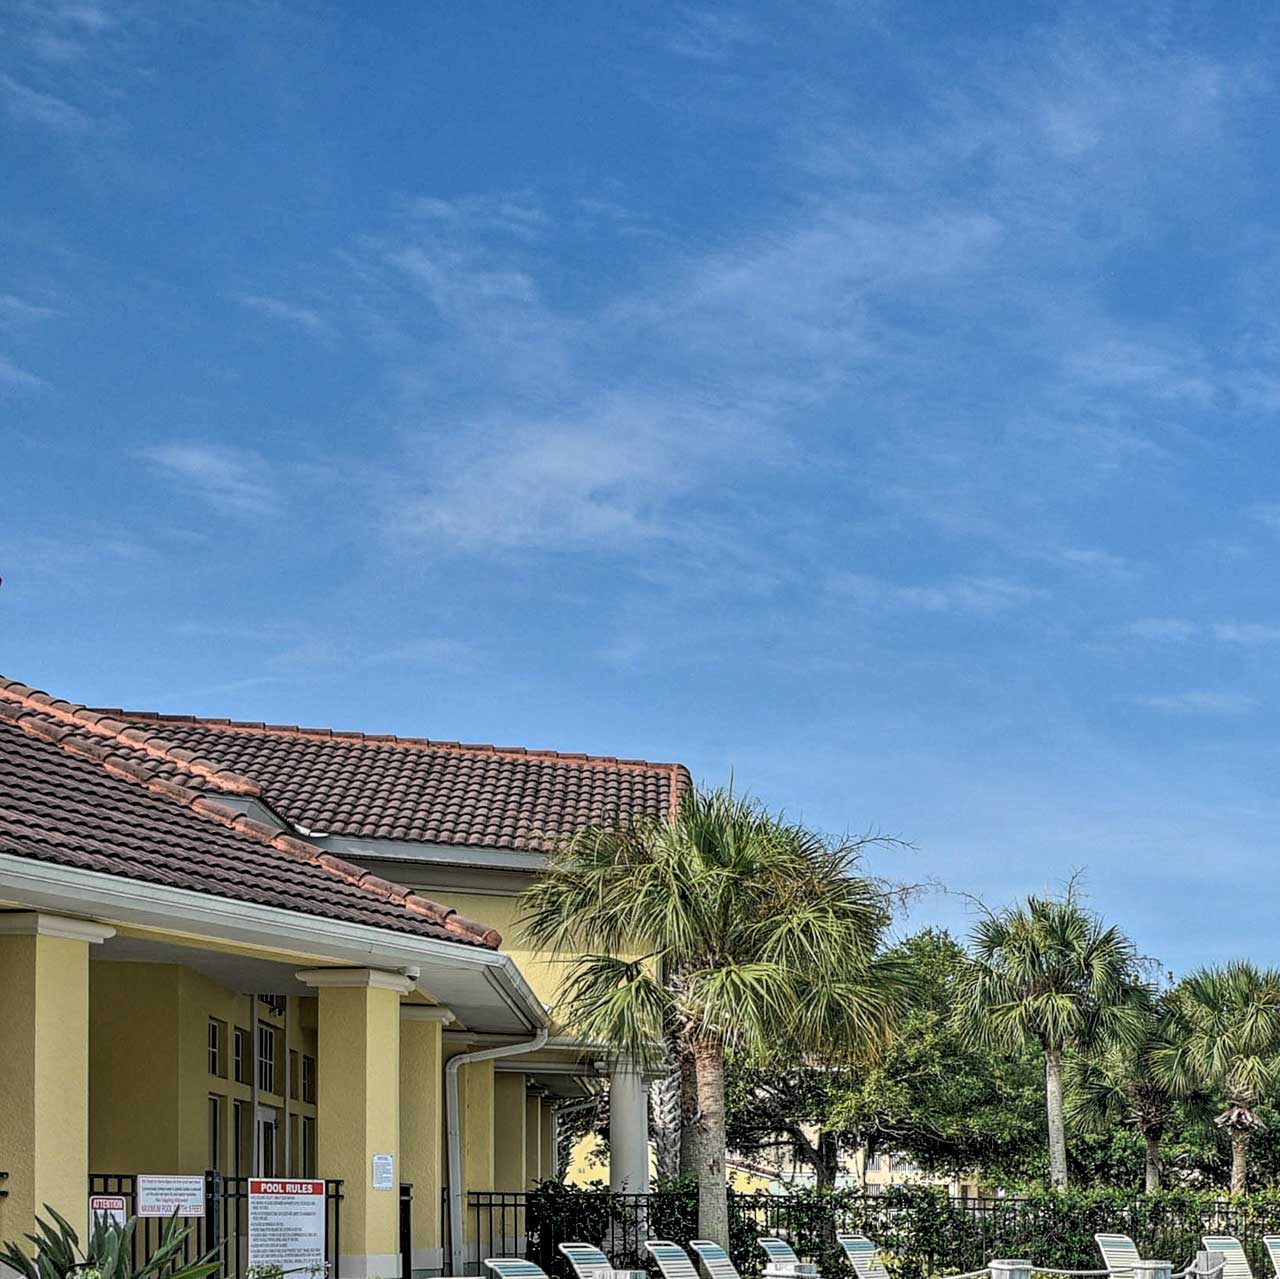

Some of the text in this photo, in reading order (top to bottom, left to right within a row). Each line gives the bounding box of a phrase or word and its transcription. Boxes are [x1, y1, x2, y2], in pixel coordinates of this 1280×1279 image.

[261, 1183, 313, 1193] POOL RULES
[92, 1199, 123, 1209] ATTENTION
